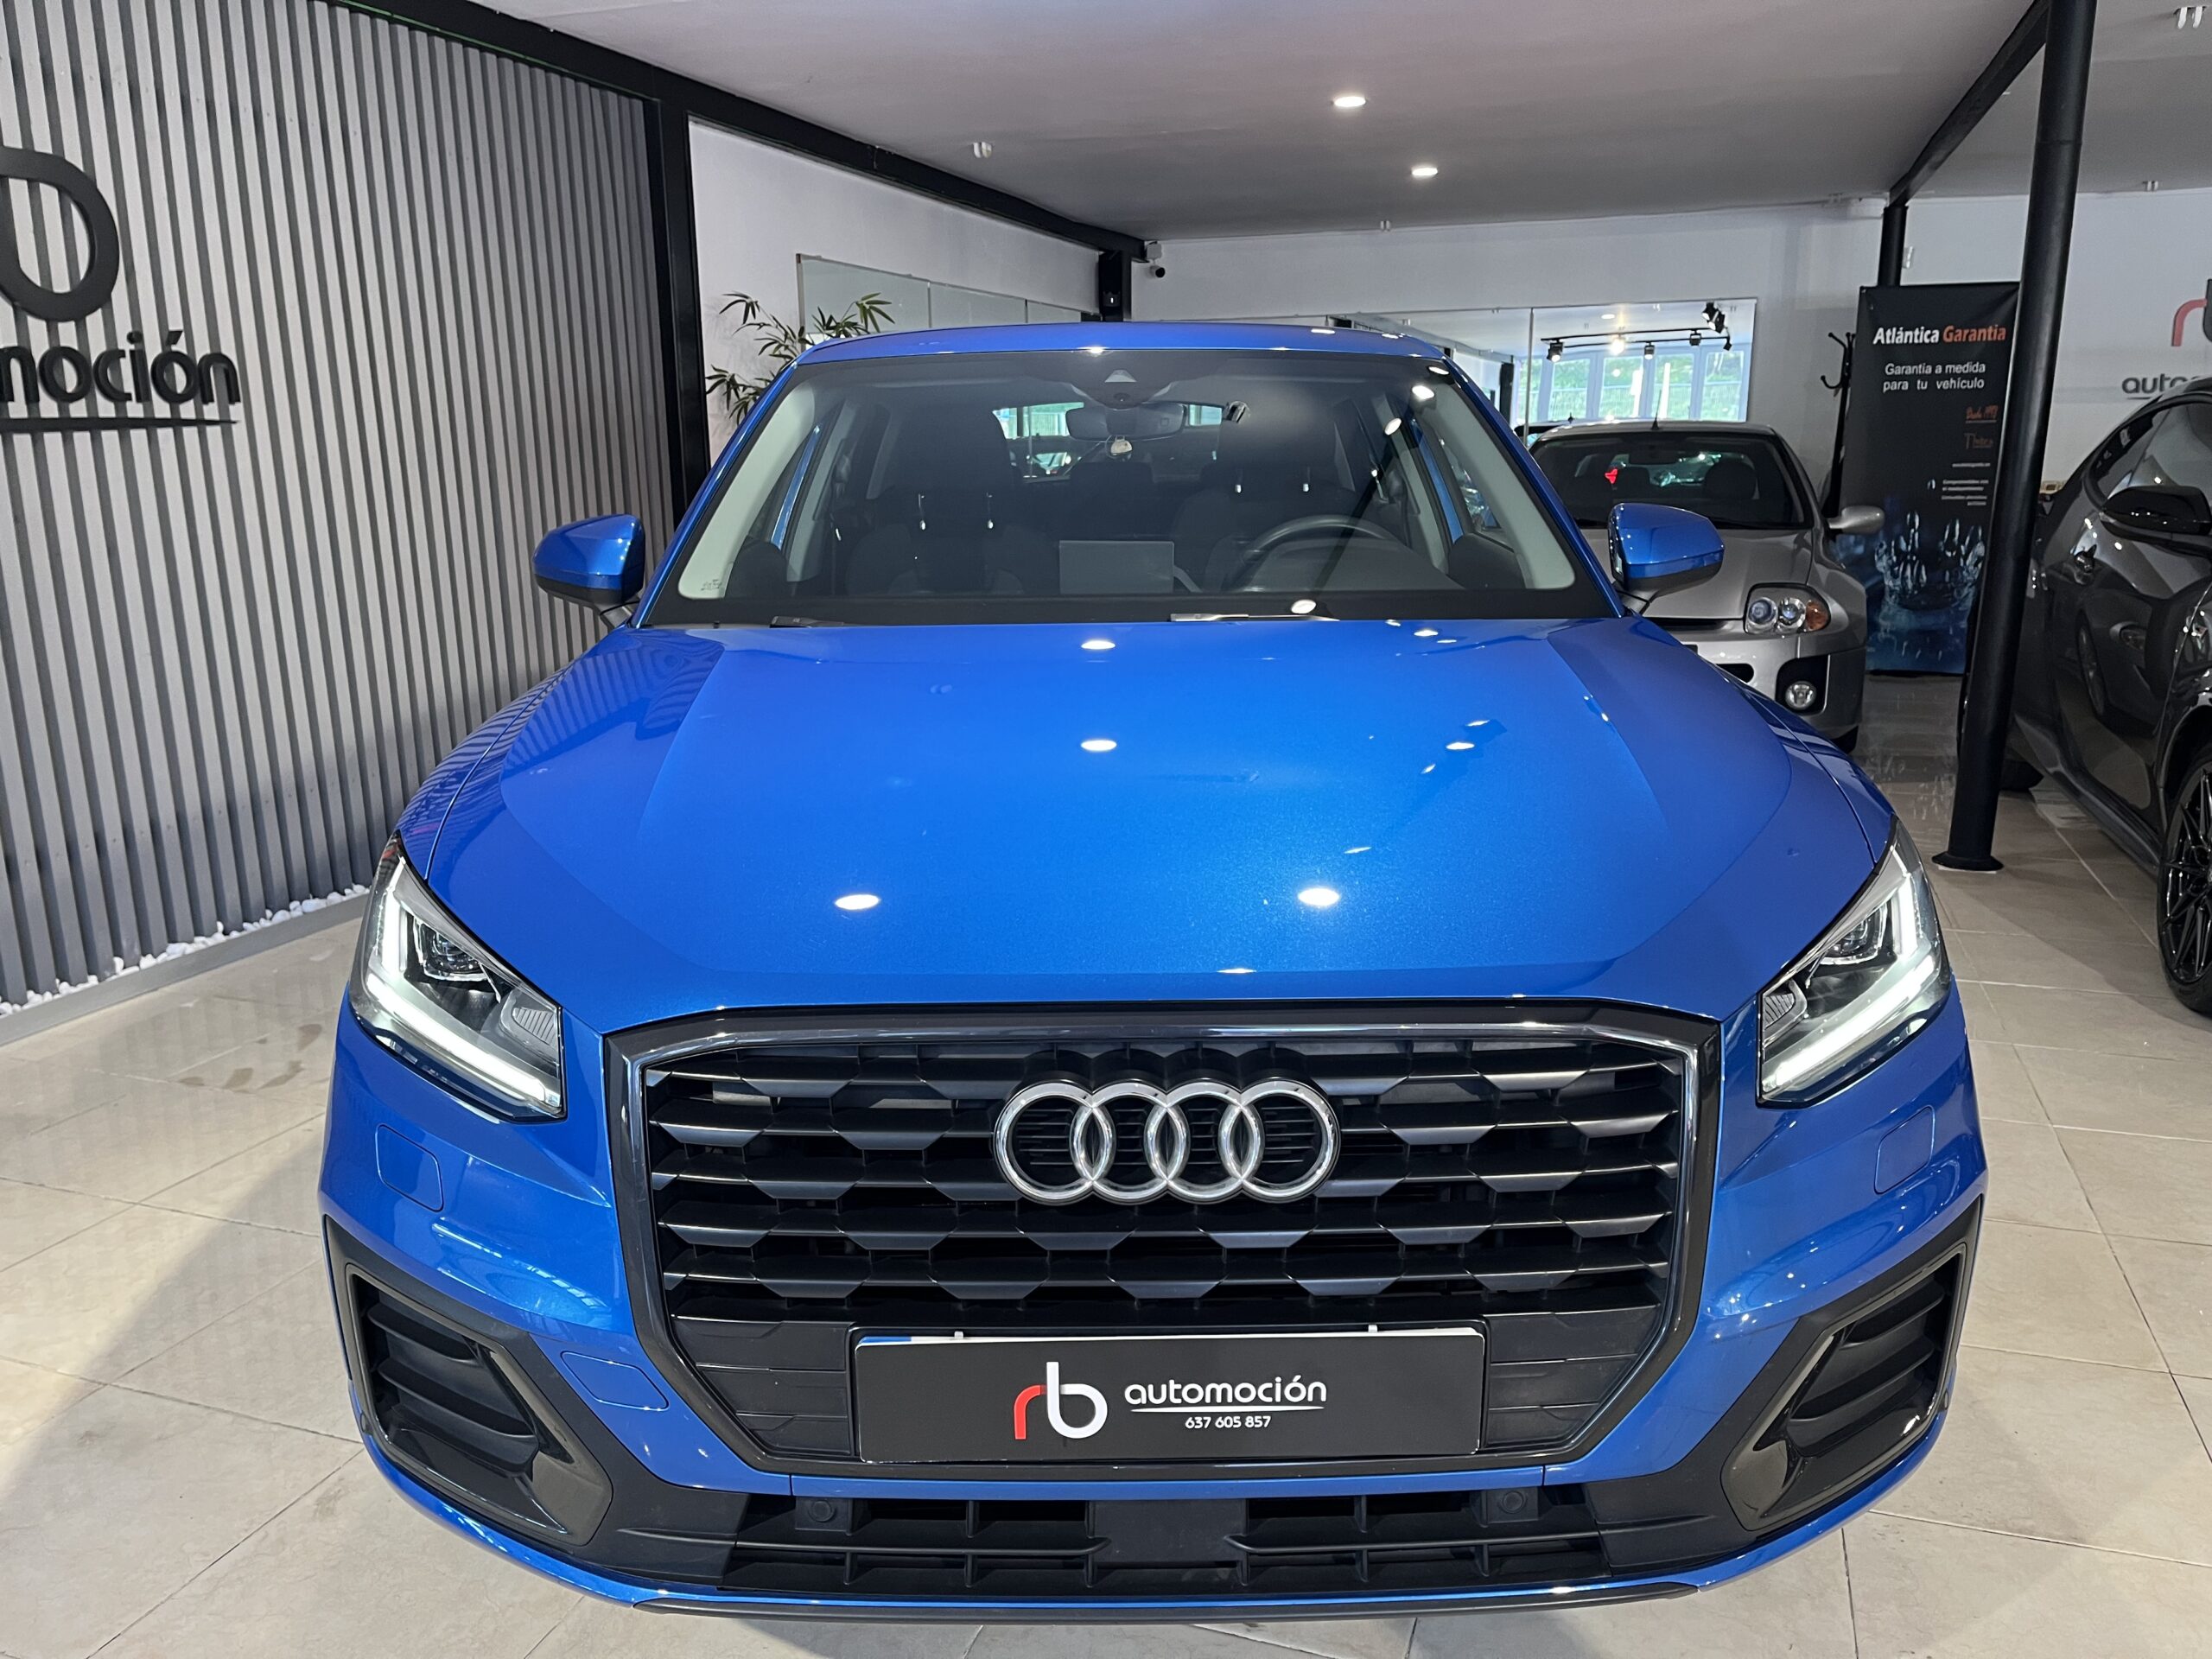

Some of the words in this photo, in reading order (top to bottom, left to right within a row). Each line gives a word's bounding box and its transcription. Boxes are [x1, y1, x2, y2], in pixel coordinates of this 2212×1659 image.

[1872, 326, 1940, 345] Atlántica
[1935, 365, 1942, 374] a
[1945, 362, 1986, 373] medida
[1883, 380, 1909, 393] para
[1916, 379, 1929, 391] tu
[1936, 377, 1985, 390] vehículo
[1124, 1375, 1327, 1405] automoción
[1014, 1361, 1108, 1440] rb
[1185, 1416, 1211, 1429] 637
[1214, 1415, 1243, 1428] 605
[1244, 1414, 1272, 1428] 857
